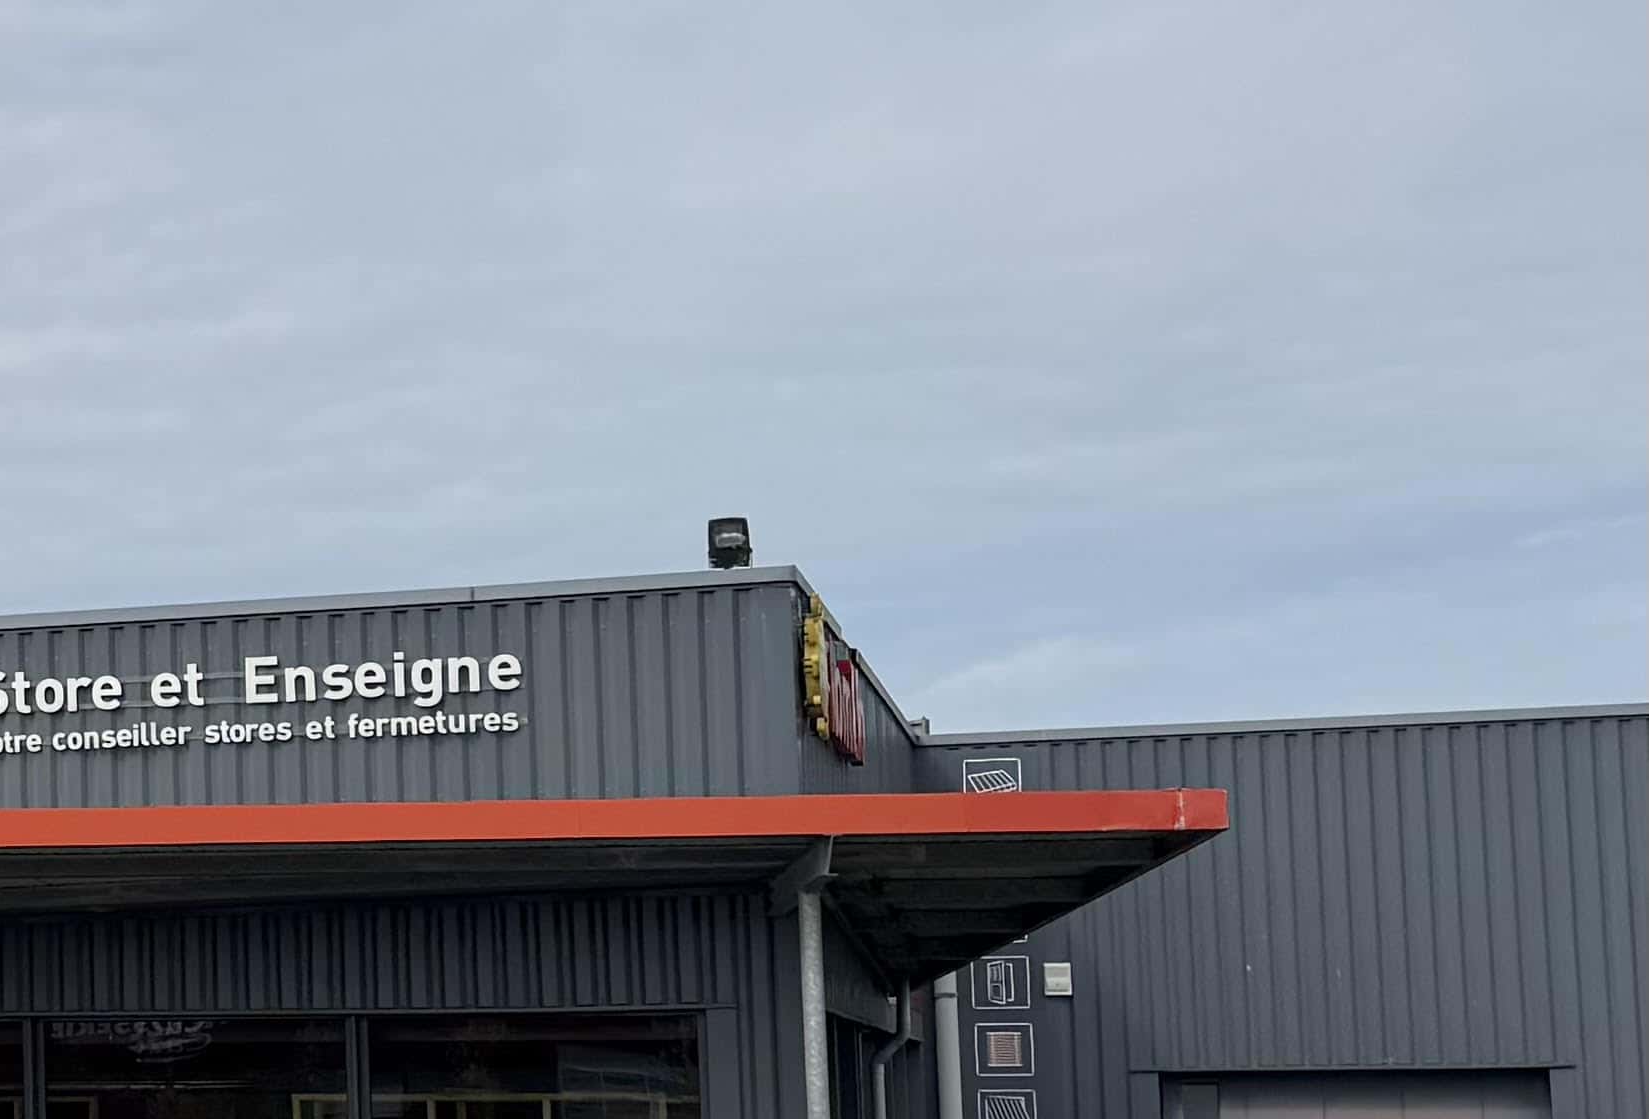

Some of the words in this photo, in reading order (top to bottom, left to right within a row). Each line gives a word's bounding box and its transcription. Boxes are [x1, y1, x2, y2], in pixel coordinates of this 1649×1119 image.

[151, 663, 204, 707] et
[245, 651, 522, 708] Enseigne
[52, 722, 192, 751] conseiller
[204, 719, 293, 744] stores
[305, 716, 336, 740] et
[348, 710, 519, 739] fermetures
